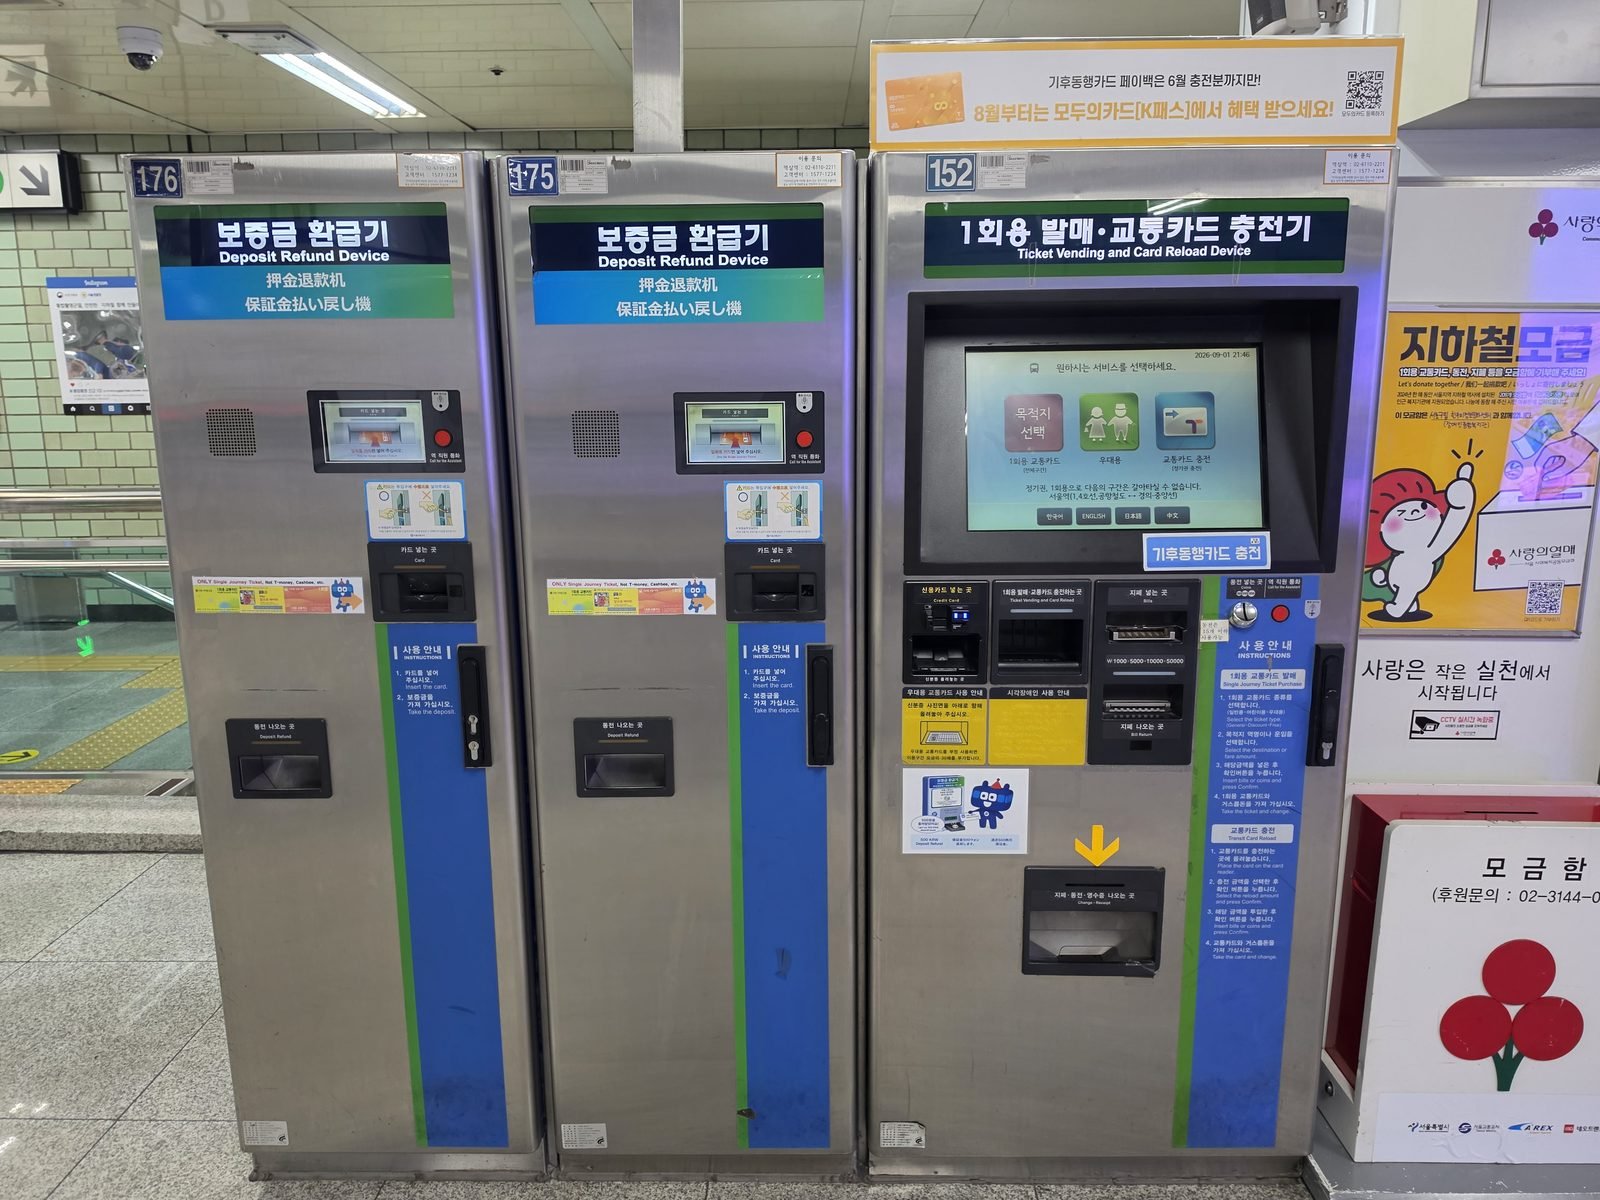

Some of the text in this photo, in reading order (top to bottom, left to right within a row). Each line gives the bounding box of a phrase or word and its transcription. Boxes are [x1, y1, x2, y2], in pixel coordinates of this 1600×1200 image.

[1049, 74, 1261, 89] 기후동행카드 페이백은 6월 충전분까지만!
[974, 100, 1334, 122] 8월부터는 모두의카드[K패스]에서 혜택 받으세요!
[136, 165, 177, 193] 176
[513, 164, 554, 190] 175
[930, 158, 973, 188] 152
[217, 220, 389, 248] 보증금 환급기
[598, 224, 769, 253] 보증금 환급기
[960, 215, 1311, 247] 1회용 발매·교통카드 충전기
[219, 250, 390, 265] Deposit Refund Device
[1017, 245, 1252, 260] Ticket Vending and Card Reload Device
[598, 254, 769, 269] Deposit Refund Device
[266, 273, 346, 288] 押金退款机
[639, 278, 718, 292] 押金退款机
[245, 296, 372, 312] 保証金払い戻し機
[616, 301, 742, 317] 保証金払い戻し機
[1399, 325, 1593, 363] 지하철모금
[1056, 362, 1177, 373] 원하시는 서비스를 선택하세요.
[1435, 381, 1460, 389] together
[1016, 407, 1051, 421] 목적지
[1021, 426, 1046, 440] 선택
[1009, 456, 1061, 466] 1회용 교통카드
[1099, 456, 1122, 465] 우대용
[1163, 455, 1211, 464] 교통카드 충전
[1025, 485, 1048, 493] 정기권,
[1051, 485, 1081, 493] 1회용으로
[1085, 484, 1106, 492] 다음의
[1131, 483, 1160, 492] 갈아타실
[1162, 483, 1169, 491] 수
[1171, 483, 1201, 491] 없습니다.
[1152, 546, 1261, 561] 기후동행카드 충전
[1509, 545, 1576, 562] 사랑의열매
[922, 586, 947, 594] 신용카드
[403, 645, 442, 655] 사용 안내
[752, 645, 790, 654] 사용 안내
[1230, 672, 1296, 680] 1회용 교통카드 발매
[1361, 659, 1551, 681] 사랑은 작은 실천에서
[1418, 685, 1498, 701] 시작됩니다
[1432, 887, 1499, 903] (후원문의
[1507, 891, 1512, 901] :
